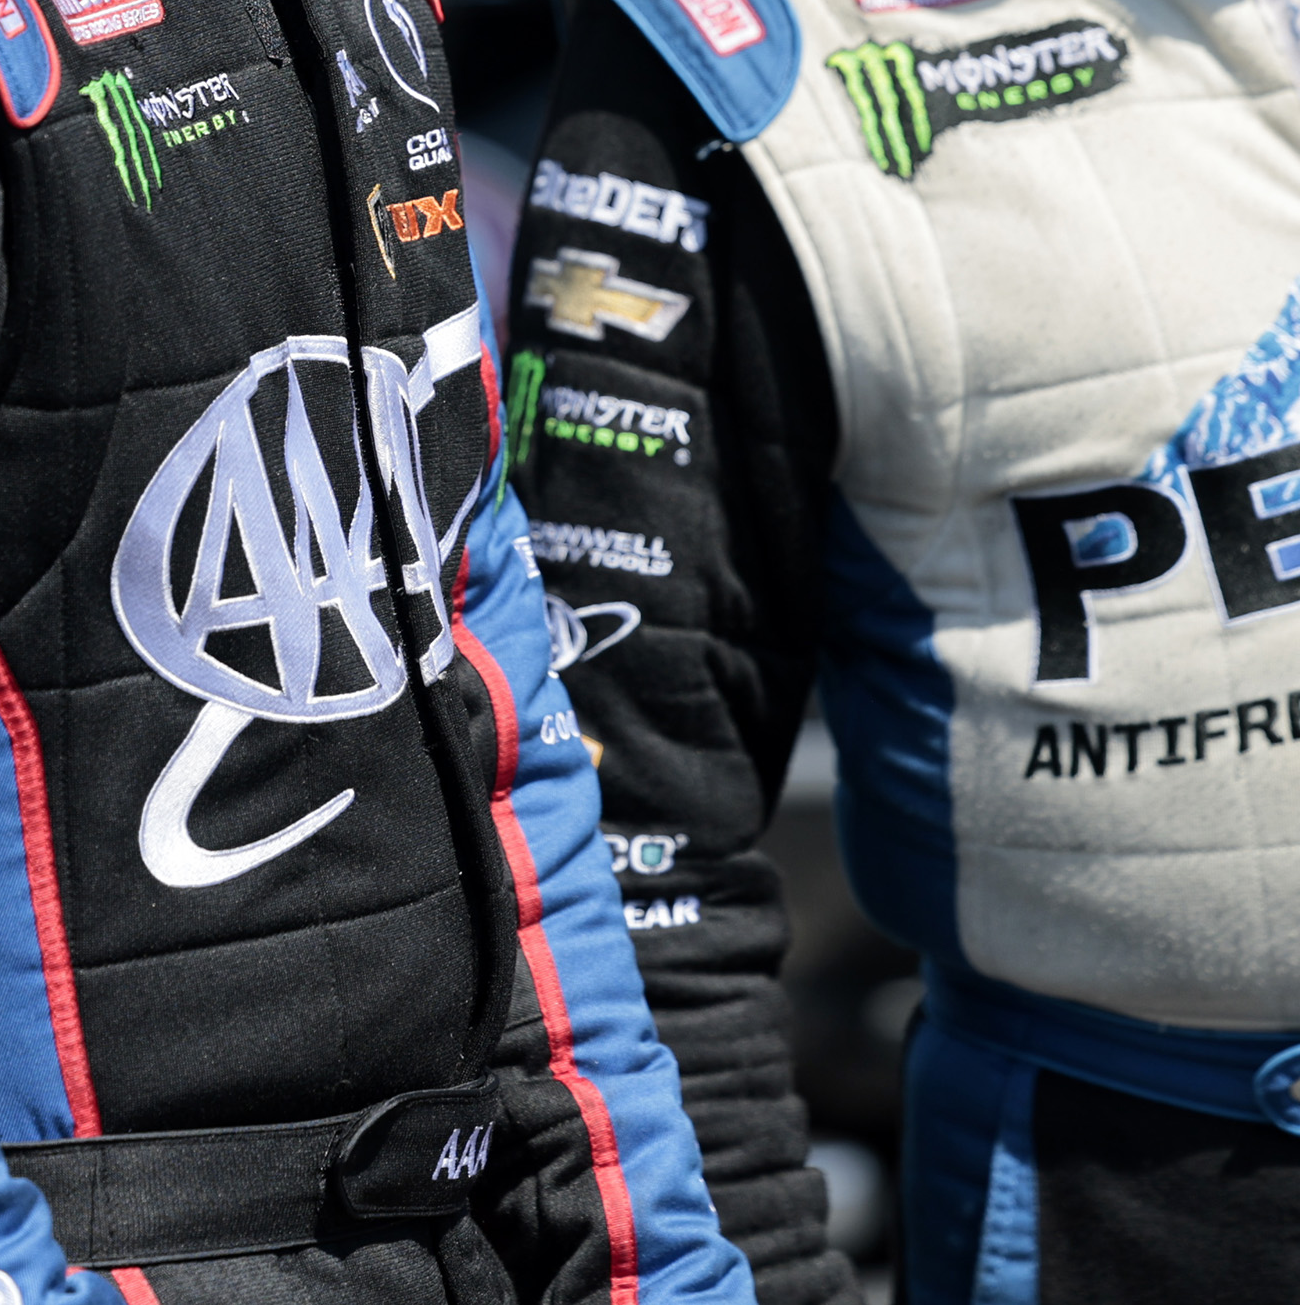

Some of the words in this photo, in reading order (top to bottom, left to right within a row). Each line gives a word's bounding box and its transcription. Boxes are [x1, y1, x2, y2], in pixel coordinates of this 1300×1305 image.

[917, 26, 1120, 95] MONSTER
[137, 72, 241, 127] MONSTER
[589, 547, 674, 576] TOOLS
